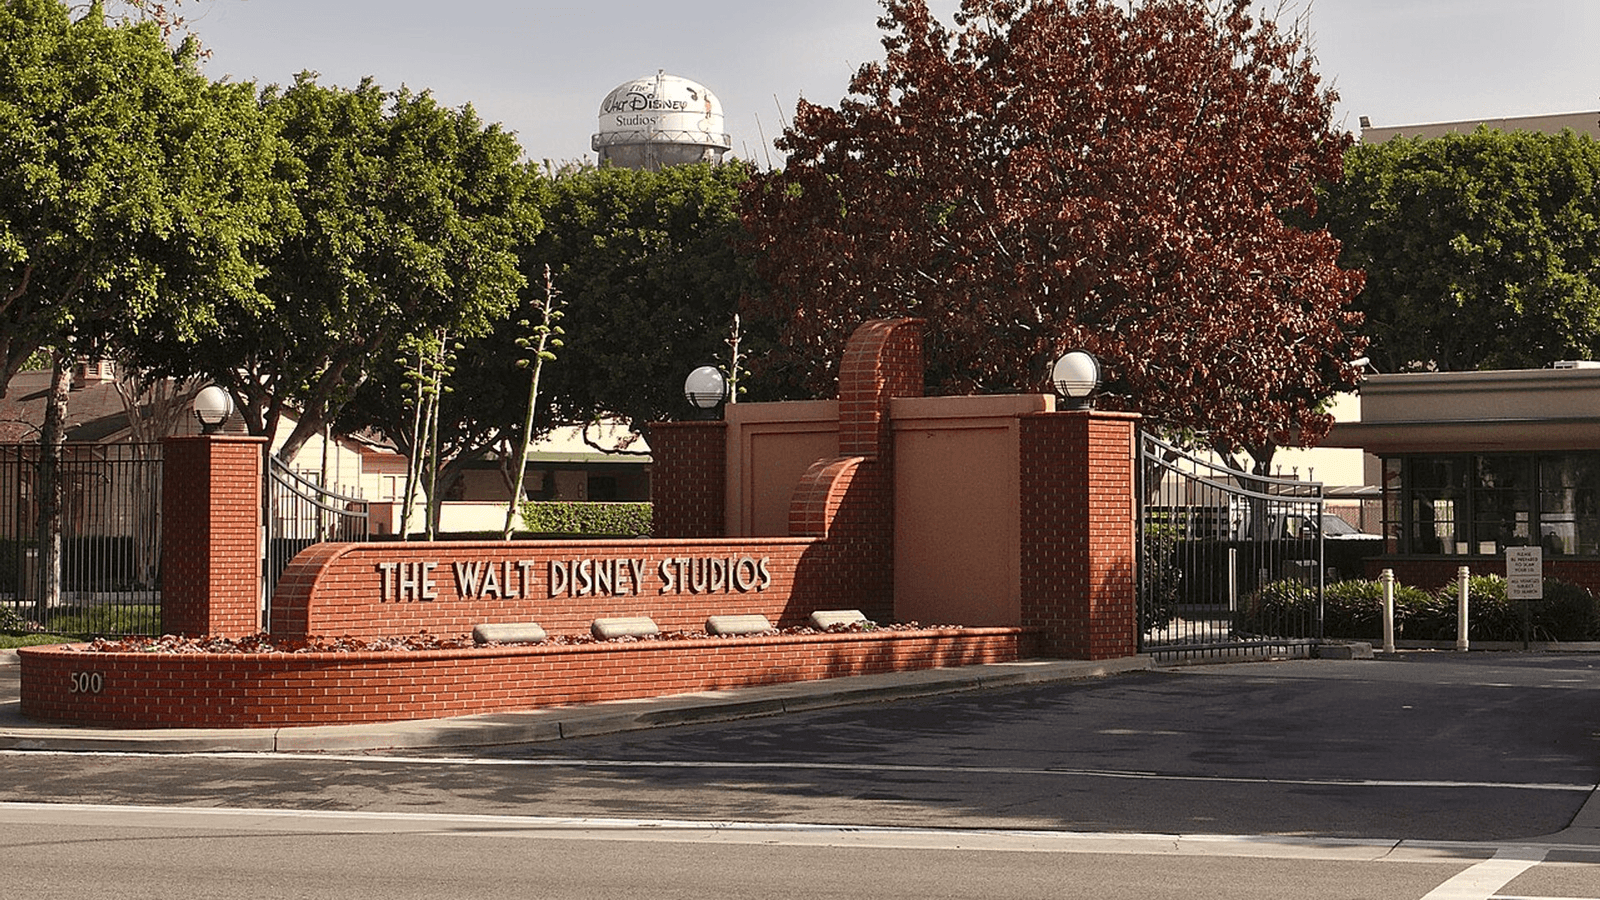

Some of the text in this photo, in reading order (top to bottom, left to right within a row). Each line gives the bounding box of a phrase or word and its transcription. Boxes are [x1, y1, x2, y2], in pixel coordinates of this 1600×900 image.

[629, 84, 649, 92] The
[616, 115, 656, 126] Studios
[376, 557, 770, 601] THE WALT DISNEY STUDIOS
[70, 672, 101, 693] 500
